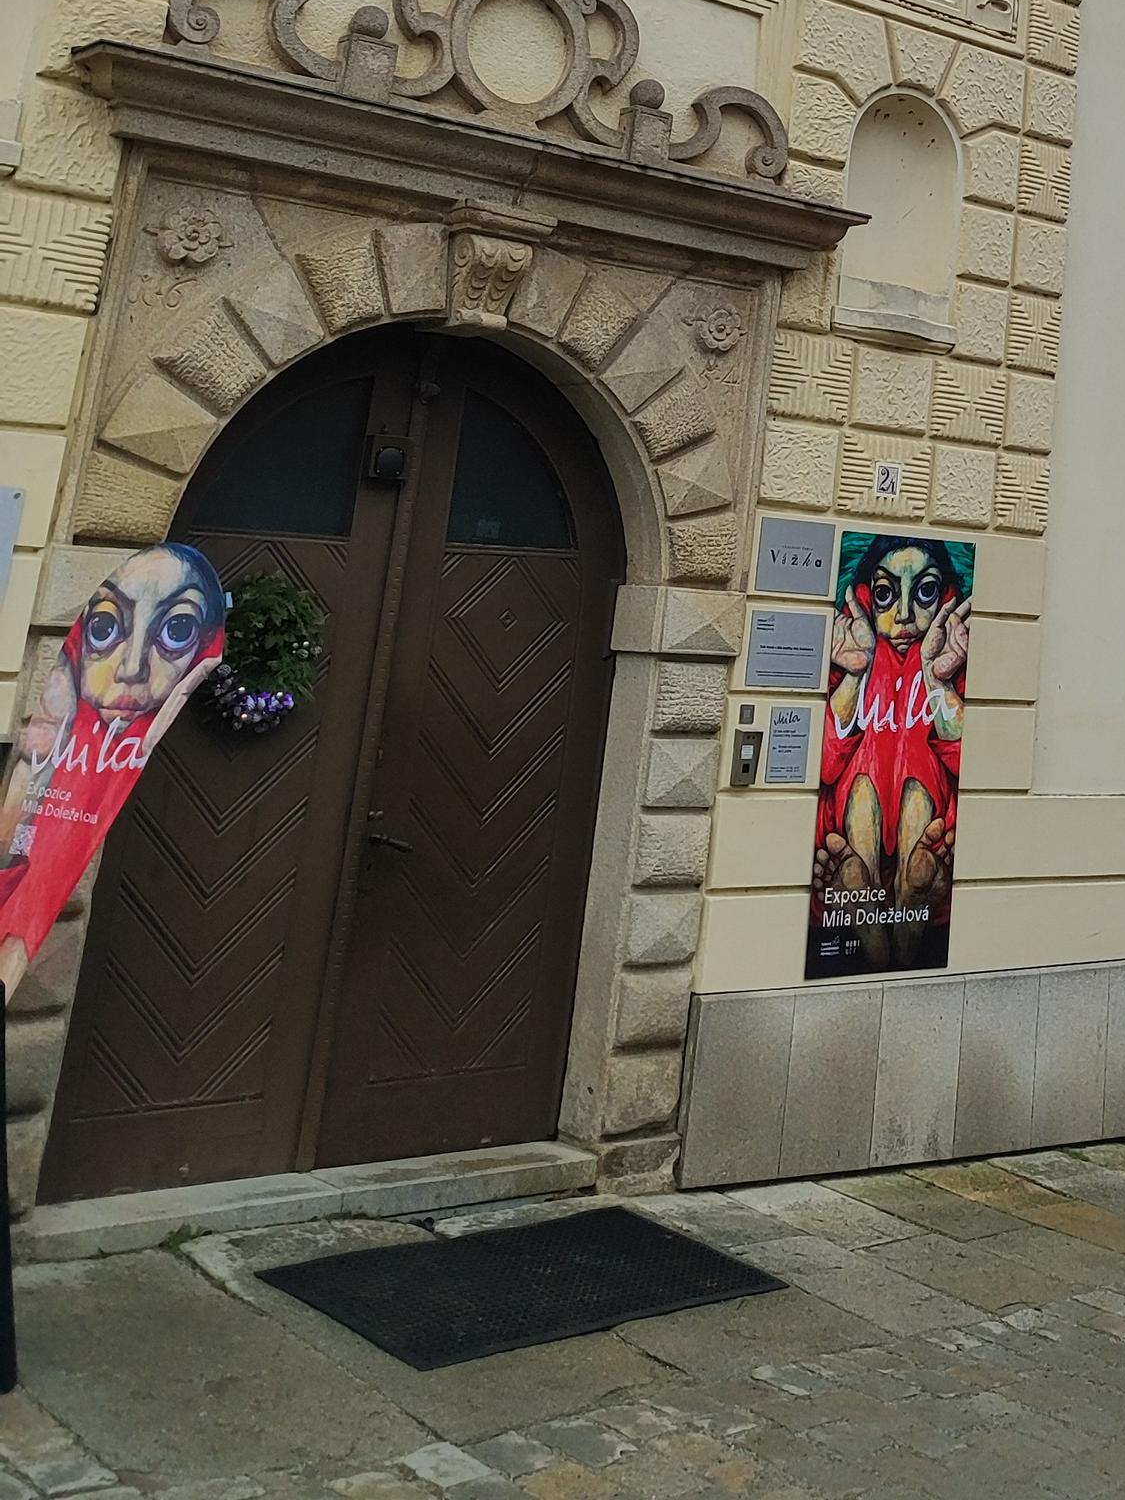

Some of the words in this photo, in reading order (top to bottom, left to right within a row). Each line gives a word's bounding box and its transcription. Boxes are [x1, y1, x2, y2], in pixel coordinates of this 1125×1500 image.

[26, 781, 72, 801] Expozice
[824, 887, 886, 906] Expozice
[856, 905, 929, 925] Doleželová
